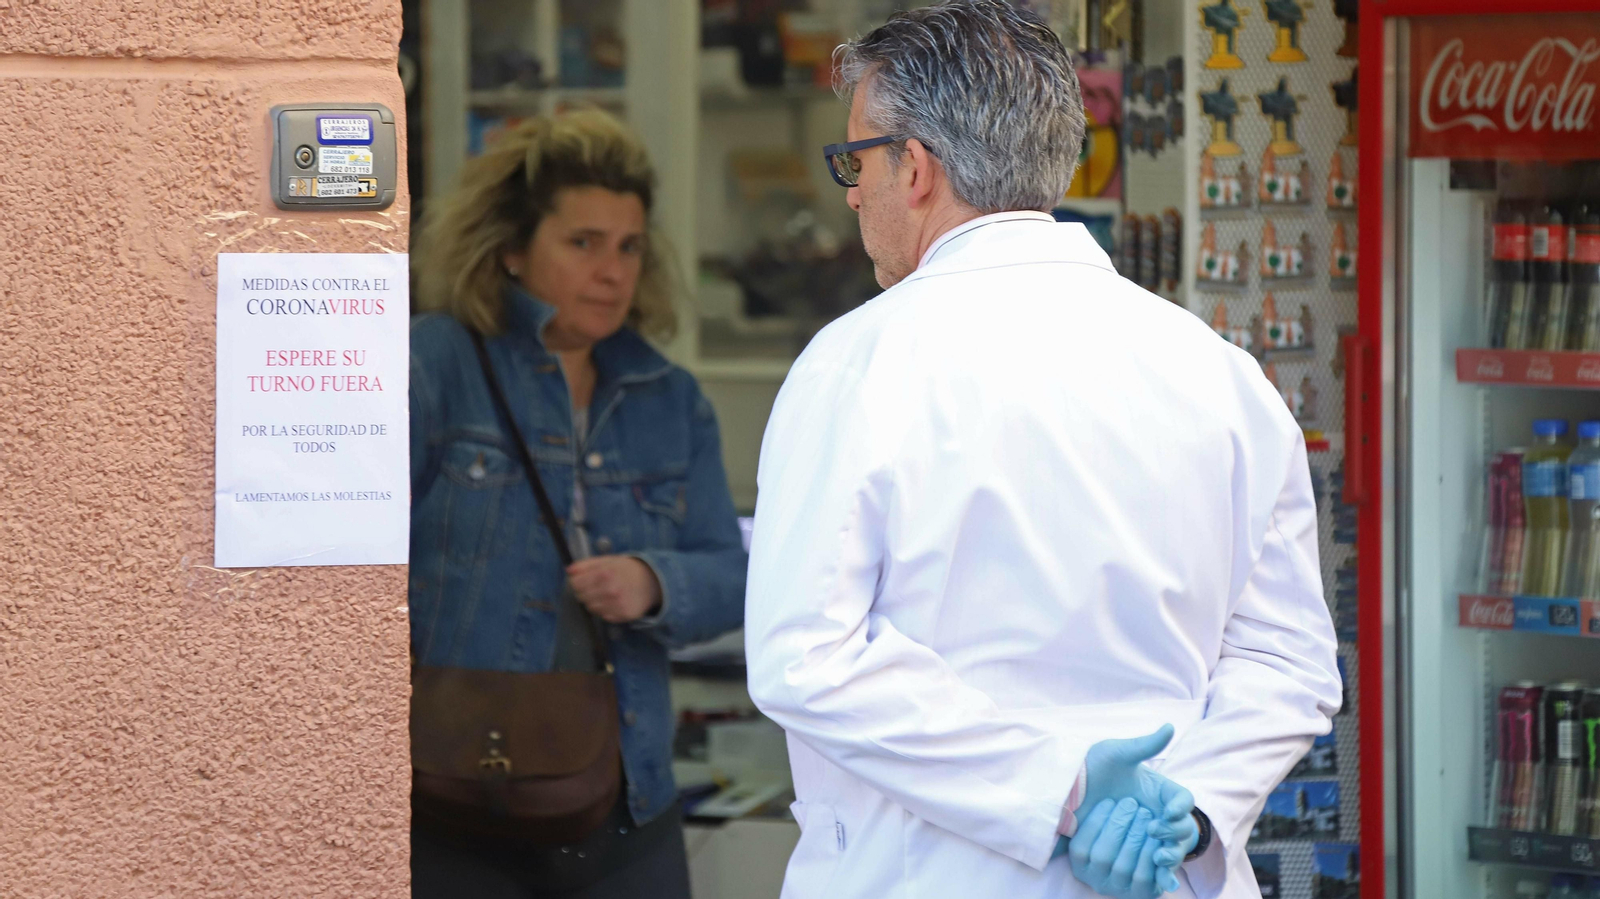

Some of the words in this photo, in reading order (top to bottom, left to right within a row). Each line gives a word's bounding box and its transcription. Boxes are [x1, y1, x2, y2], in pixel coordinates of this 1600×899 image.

[317, 176, 359, 184] CERRAJERO
[241, 278, 309, 291] MEDIDAS
[311, 278, 371, 291] CONTRA
[373, 278, 390, 291] EL
[246, 298, 386, 315] CORONAVIRUS
[265, 350, 337, 367] ESPERE
[342, 350, 366, 367] SU
[247, 375, 315, 392] TURNO
[320, 375, 384, 392] FUERA
[242, 425, 268, 437] POR
[271, 425, 288, 437] LA
[291, 424, 367, 436] SEGURIDAD
[370, 424, 388, 436] DE
[293, 441, 336, 453] TODOS
[235, 492, 309, 502] LAMENTAMOS
[311, 492, 331, 502] LAS
[333, 491, 392, 501] MOLESTIAS
